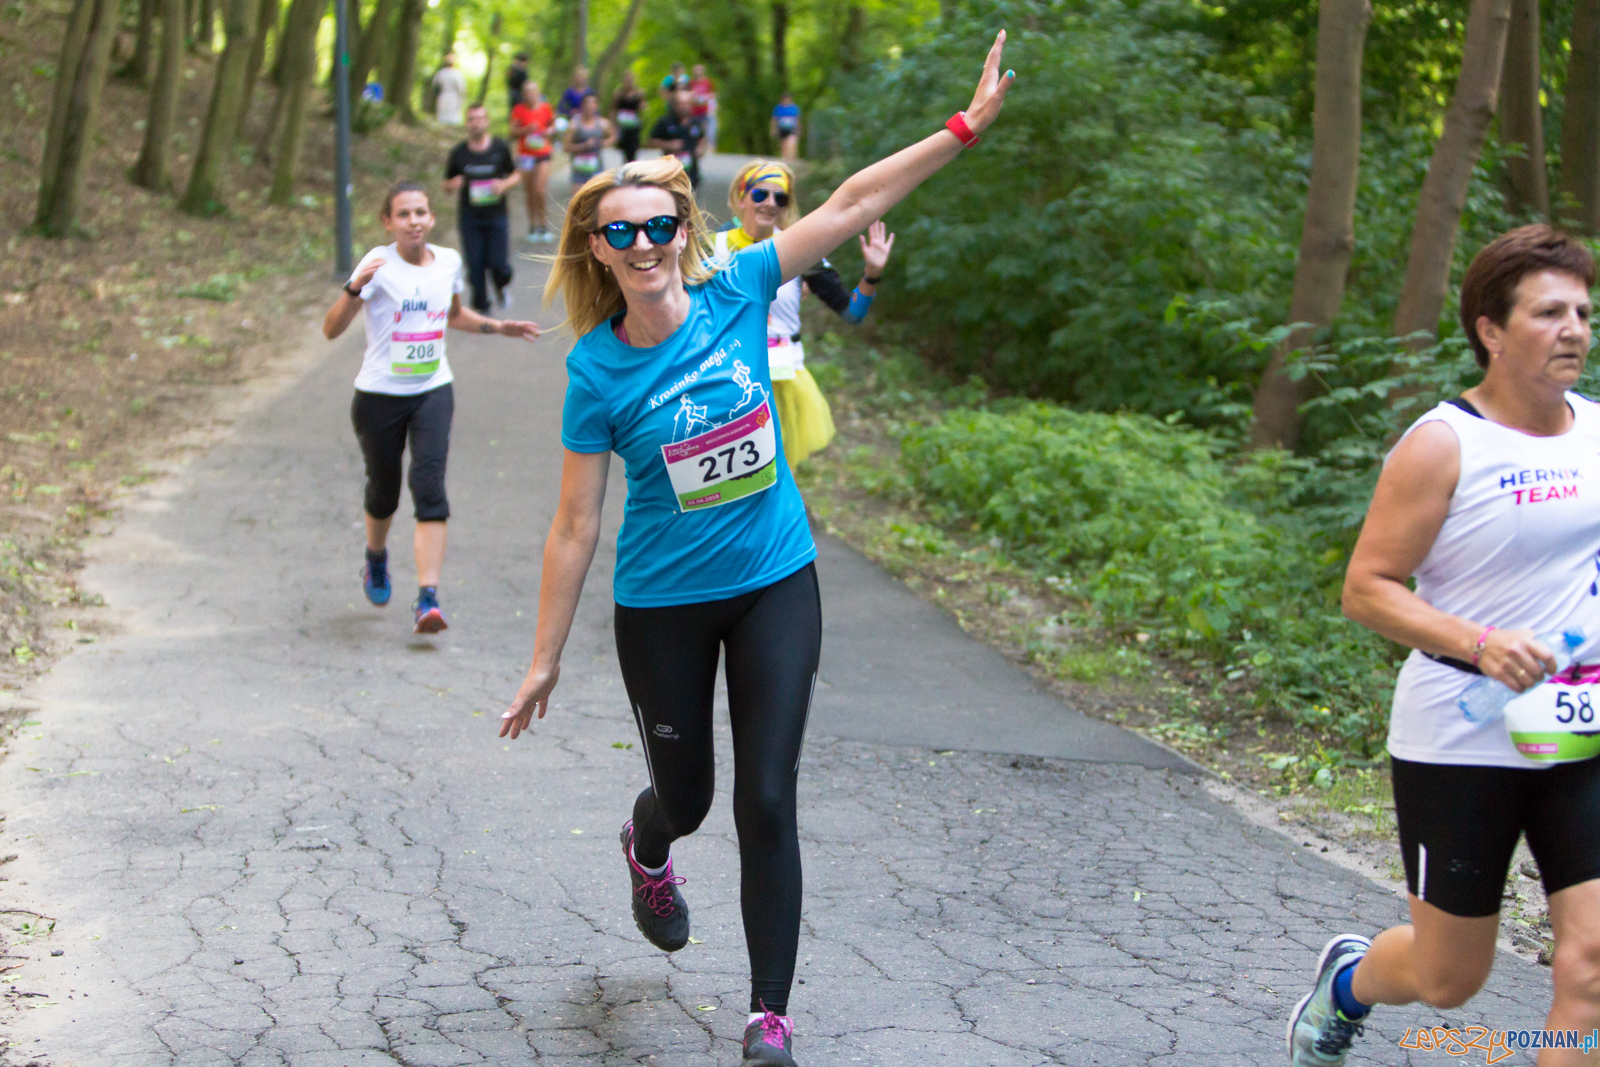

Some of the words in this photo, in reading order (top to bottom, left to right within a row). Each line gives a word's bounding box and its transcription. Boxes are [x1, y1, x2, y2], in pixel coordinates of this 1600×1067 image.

[402, 299, 428, 312] RUN
[406, 344, 435, 360] 208
[647, 370, 698, 409] Krosinko
[698, 440, 760, 483] 273
[1500, 467, 1584, 489] HERNIK
[1512, 485, 1578, 506] TEAM
[1556, 691, 1594, 724] 58
